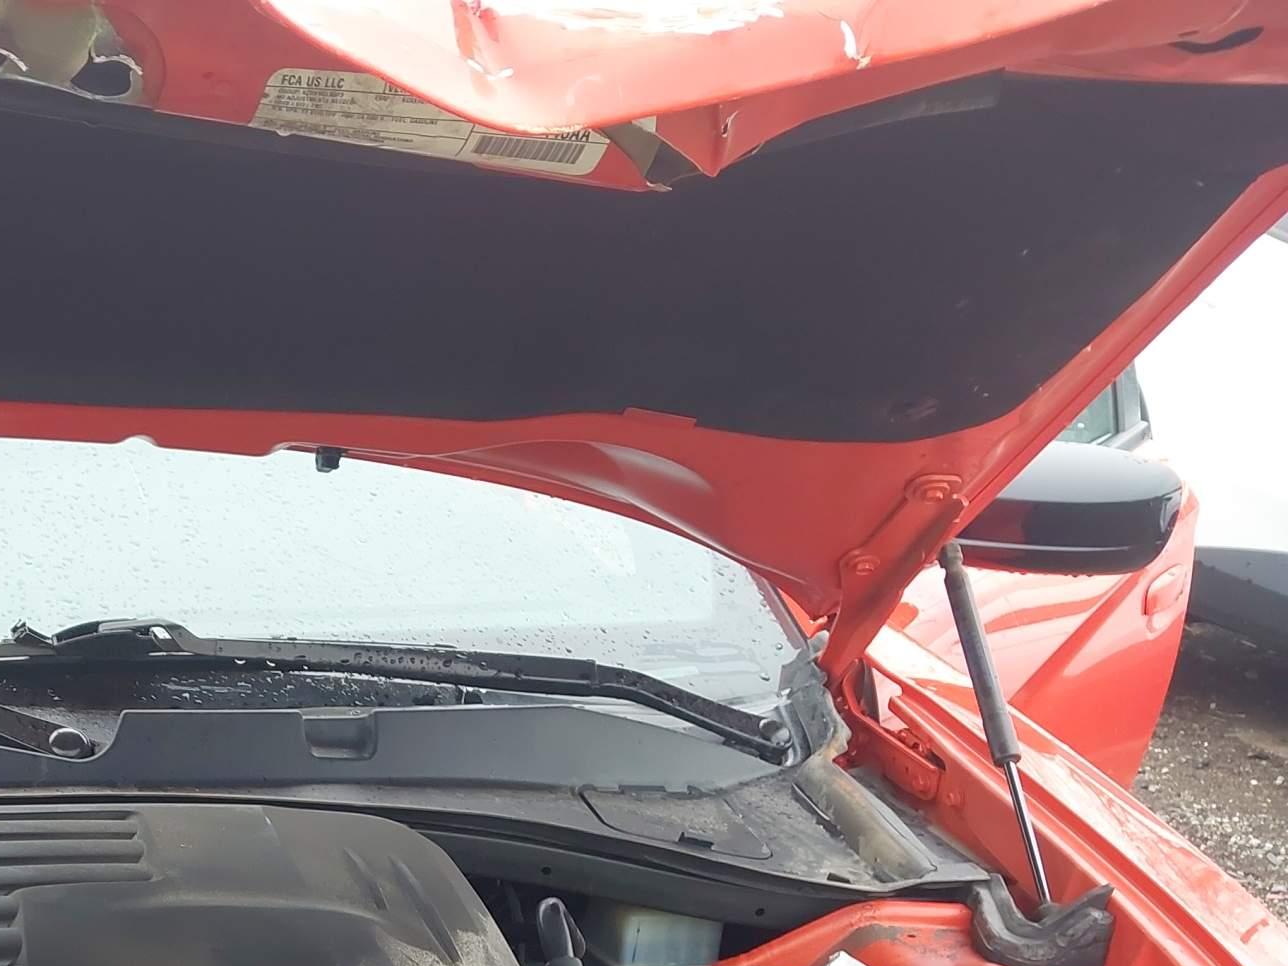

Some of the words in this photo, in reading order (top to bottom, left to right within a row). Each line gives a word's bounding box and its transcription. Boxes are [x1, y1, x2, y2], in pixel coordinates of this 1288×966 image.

[281, 74, 302, 87] FCA
[306, 76, 322, 87] US
[324, 77, 345, 89] LLC
